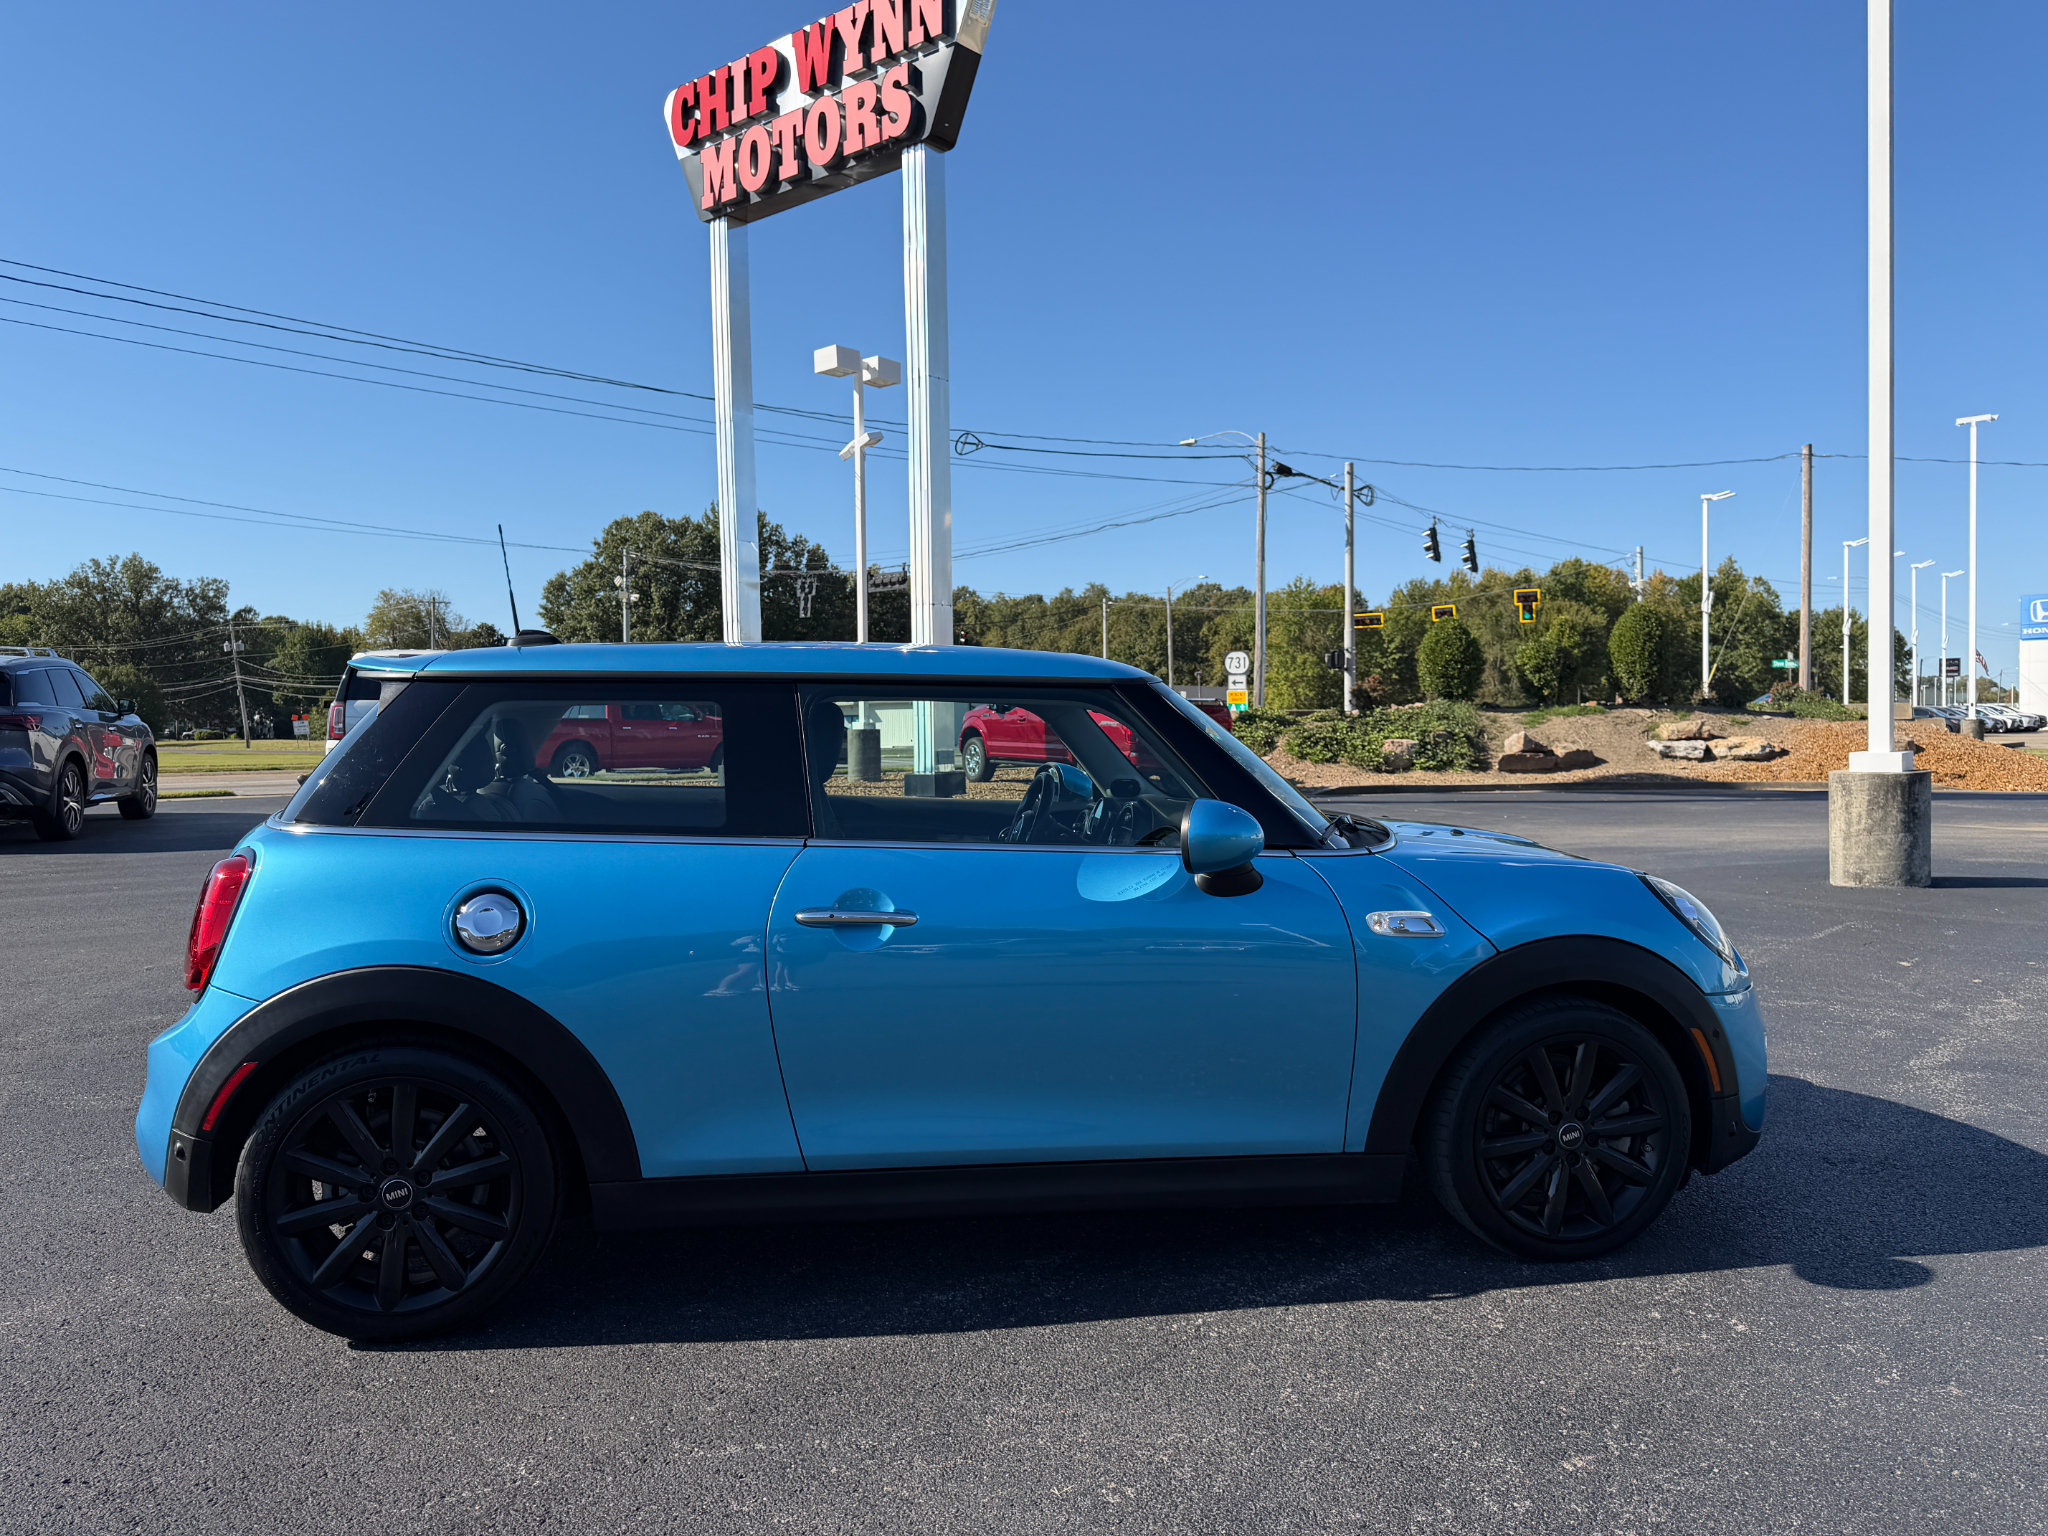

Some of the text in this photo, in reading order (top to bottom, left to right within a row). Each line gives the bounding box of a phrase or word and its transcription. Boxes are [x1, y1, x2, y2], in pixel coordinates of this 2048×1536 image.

[671, 0, 943, 147] CHIP WYNN
[700, 62, 912, 210] MOTORS
[1227, 656, 1246, 669] 731
[1562, 1130, 1580, 1142] MINI
[386, 1187, 408, 1201] MINI
